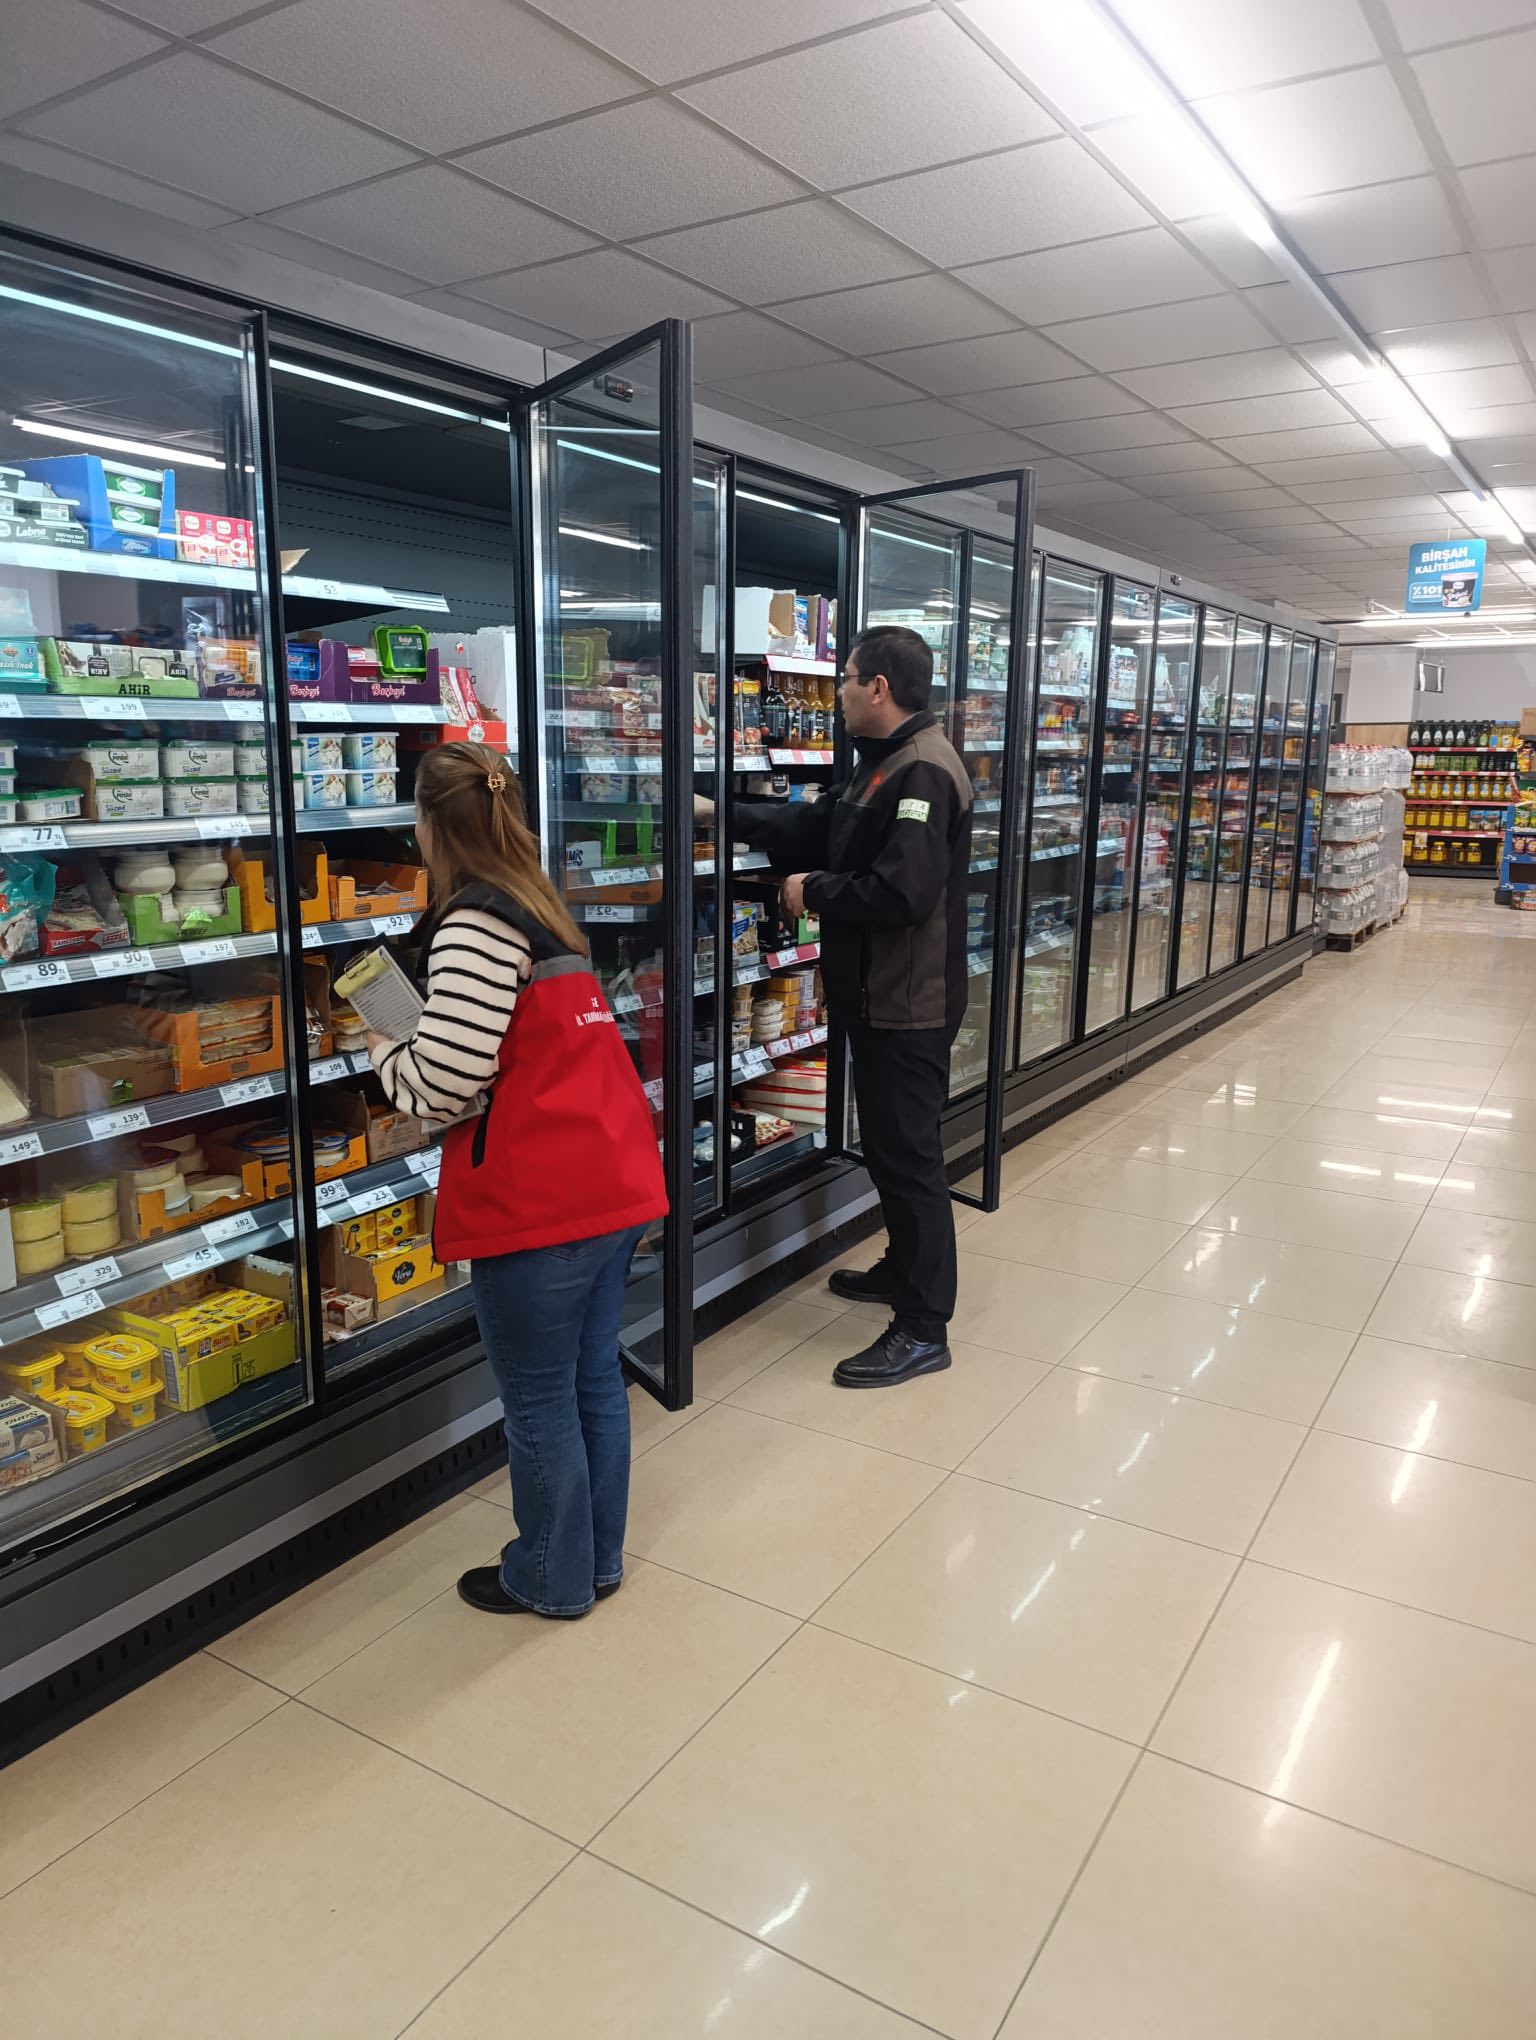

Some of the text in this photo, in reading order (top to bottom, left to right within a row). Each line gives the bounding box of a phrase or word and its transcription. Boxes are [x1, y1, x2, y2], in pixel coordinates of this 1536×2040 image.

[1421, 547, 1468, 563] BİRŞAH
[1415, 559, 1476, 575] KALİTESİNİN
[32, 828, 52, 841] 77
[390, 916, 404, 927] 92
[38, 963, 57, 976] 89
[123, 1113, 140, 1123] 139
[12, 1141, 31, 1153] 149
[320, 1185, 336, 1198] 99
[373, 1190, 387, 1201] 23
[235, 1218, 250, 1228] 182
[194, 1249, 212, 1261] 45
[95, 1265, 112, 1277] 329
